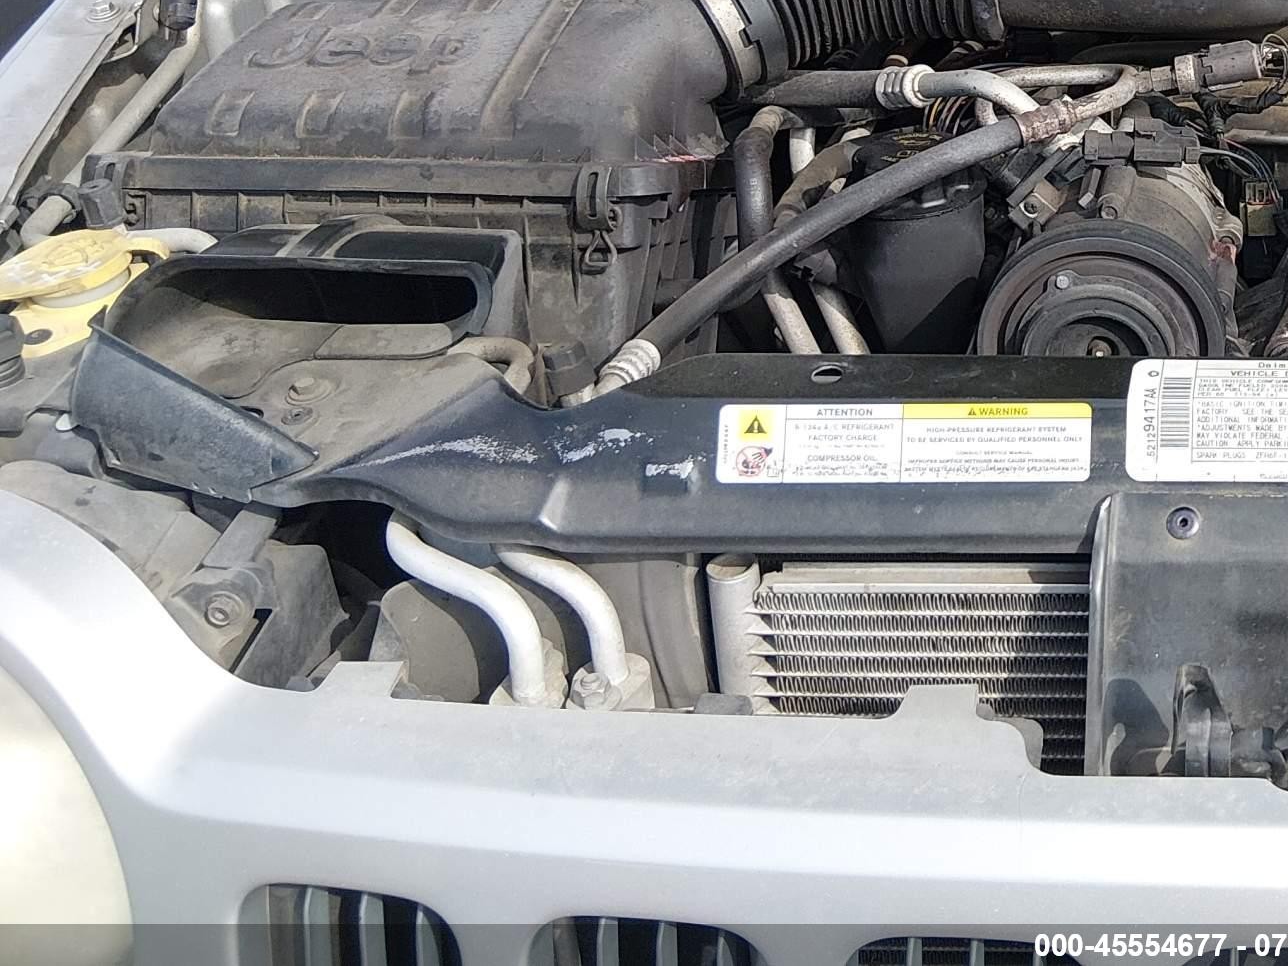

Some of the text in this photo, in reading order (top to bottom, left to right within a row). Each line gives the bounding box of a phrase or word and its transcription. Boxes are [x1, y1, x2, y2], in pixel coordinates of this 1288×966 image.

[247, 23, 481, 76] Jeep
[816, 408, 873, 416] ATTENTION
[979, 407, 1029, 416] WARNING
